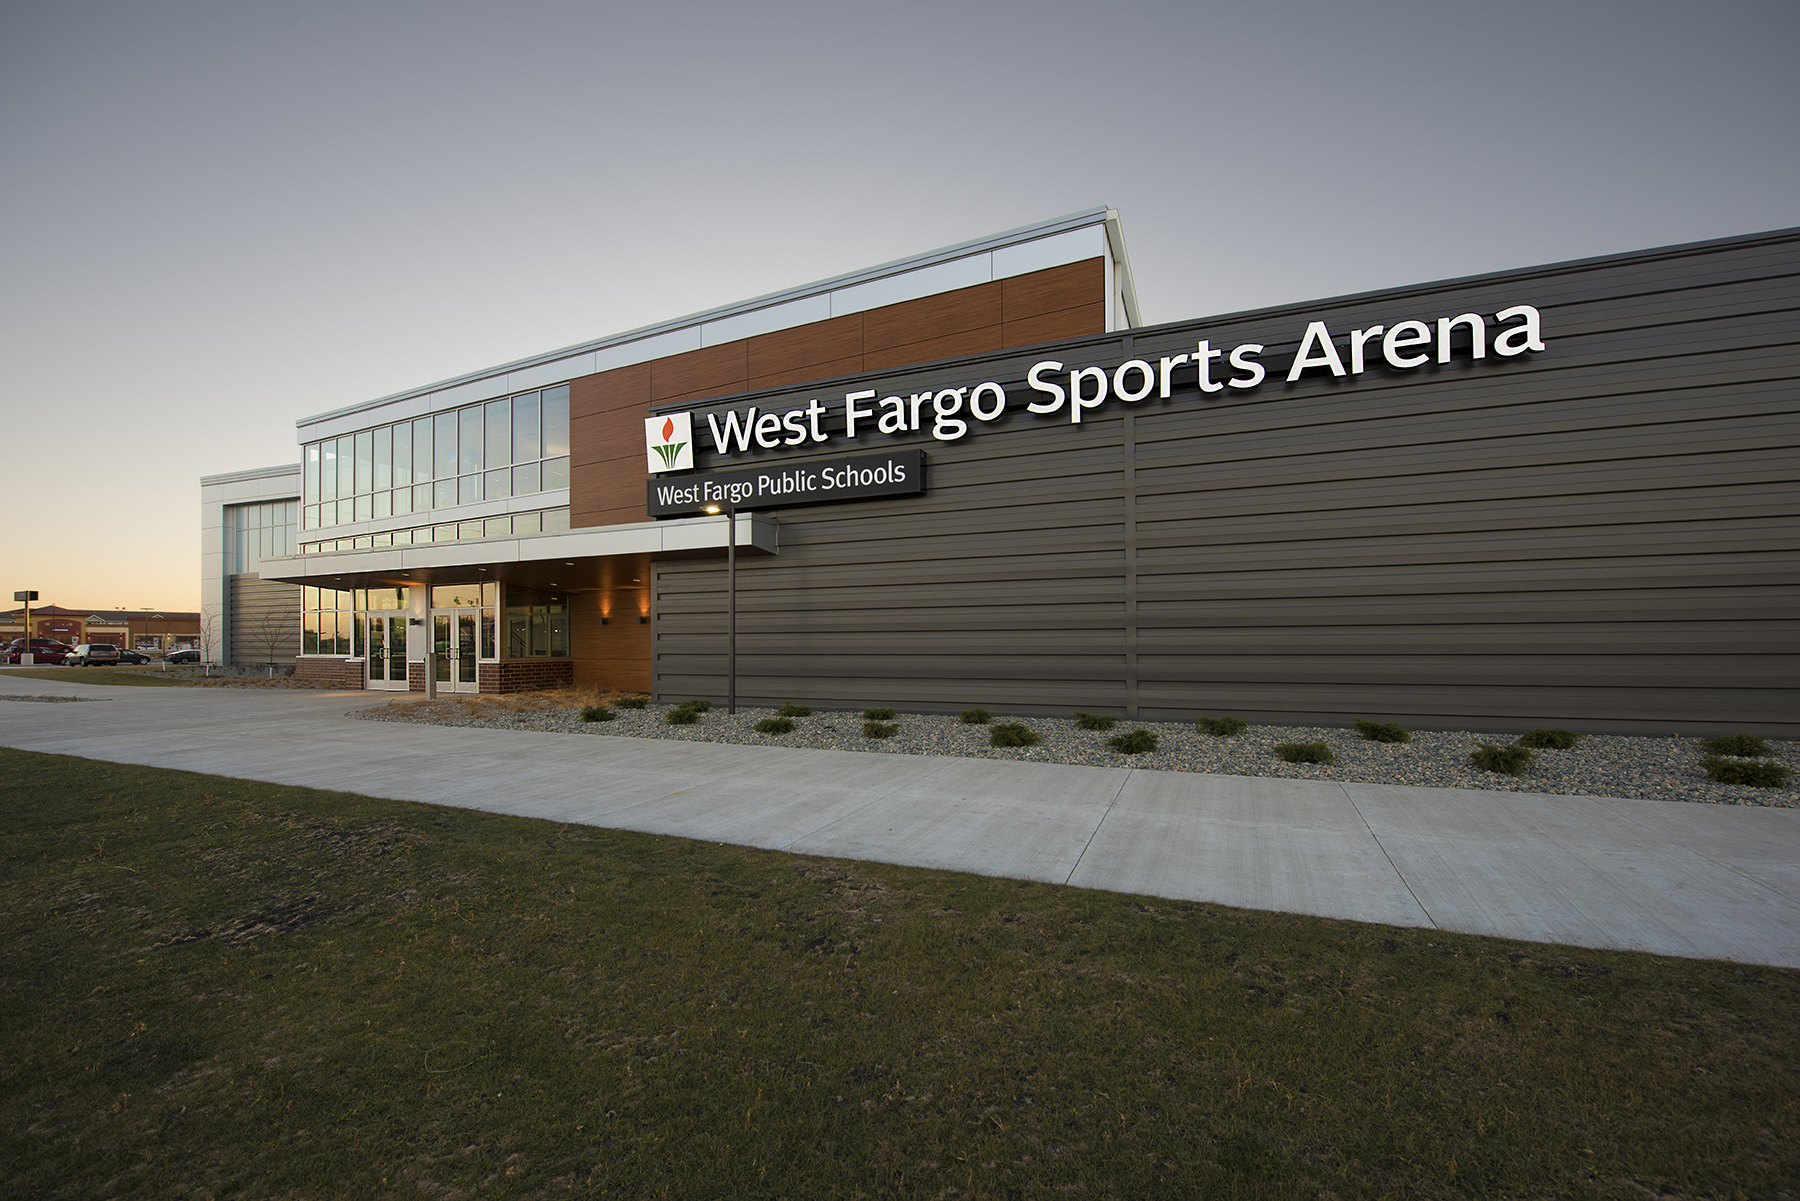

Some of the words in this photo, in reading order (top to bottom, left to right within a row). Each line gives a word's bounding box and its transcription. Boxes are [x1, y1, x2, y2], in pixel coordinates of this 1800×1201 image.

[707, 400, 828, 454] West
[846, 382, 1005, 441] Fargo
[1027, 340, 1265, 423] Sports
[1287, 306, 1546, 381] Arena
[657, 484, 700, 506] West
[705, 480, 753, 503] Fargo
[759, 471, 818, 496] Public
[822, 460, 907, 490] Schools
